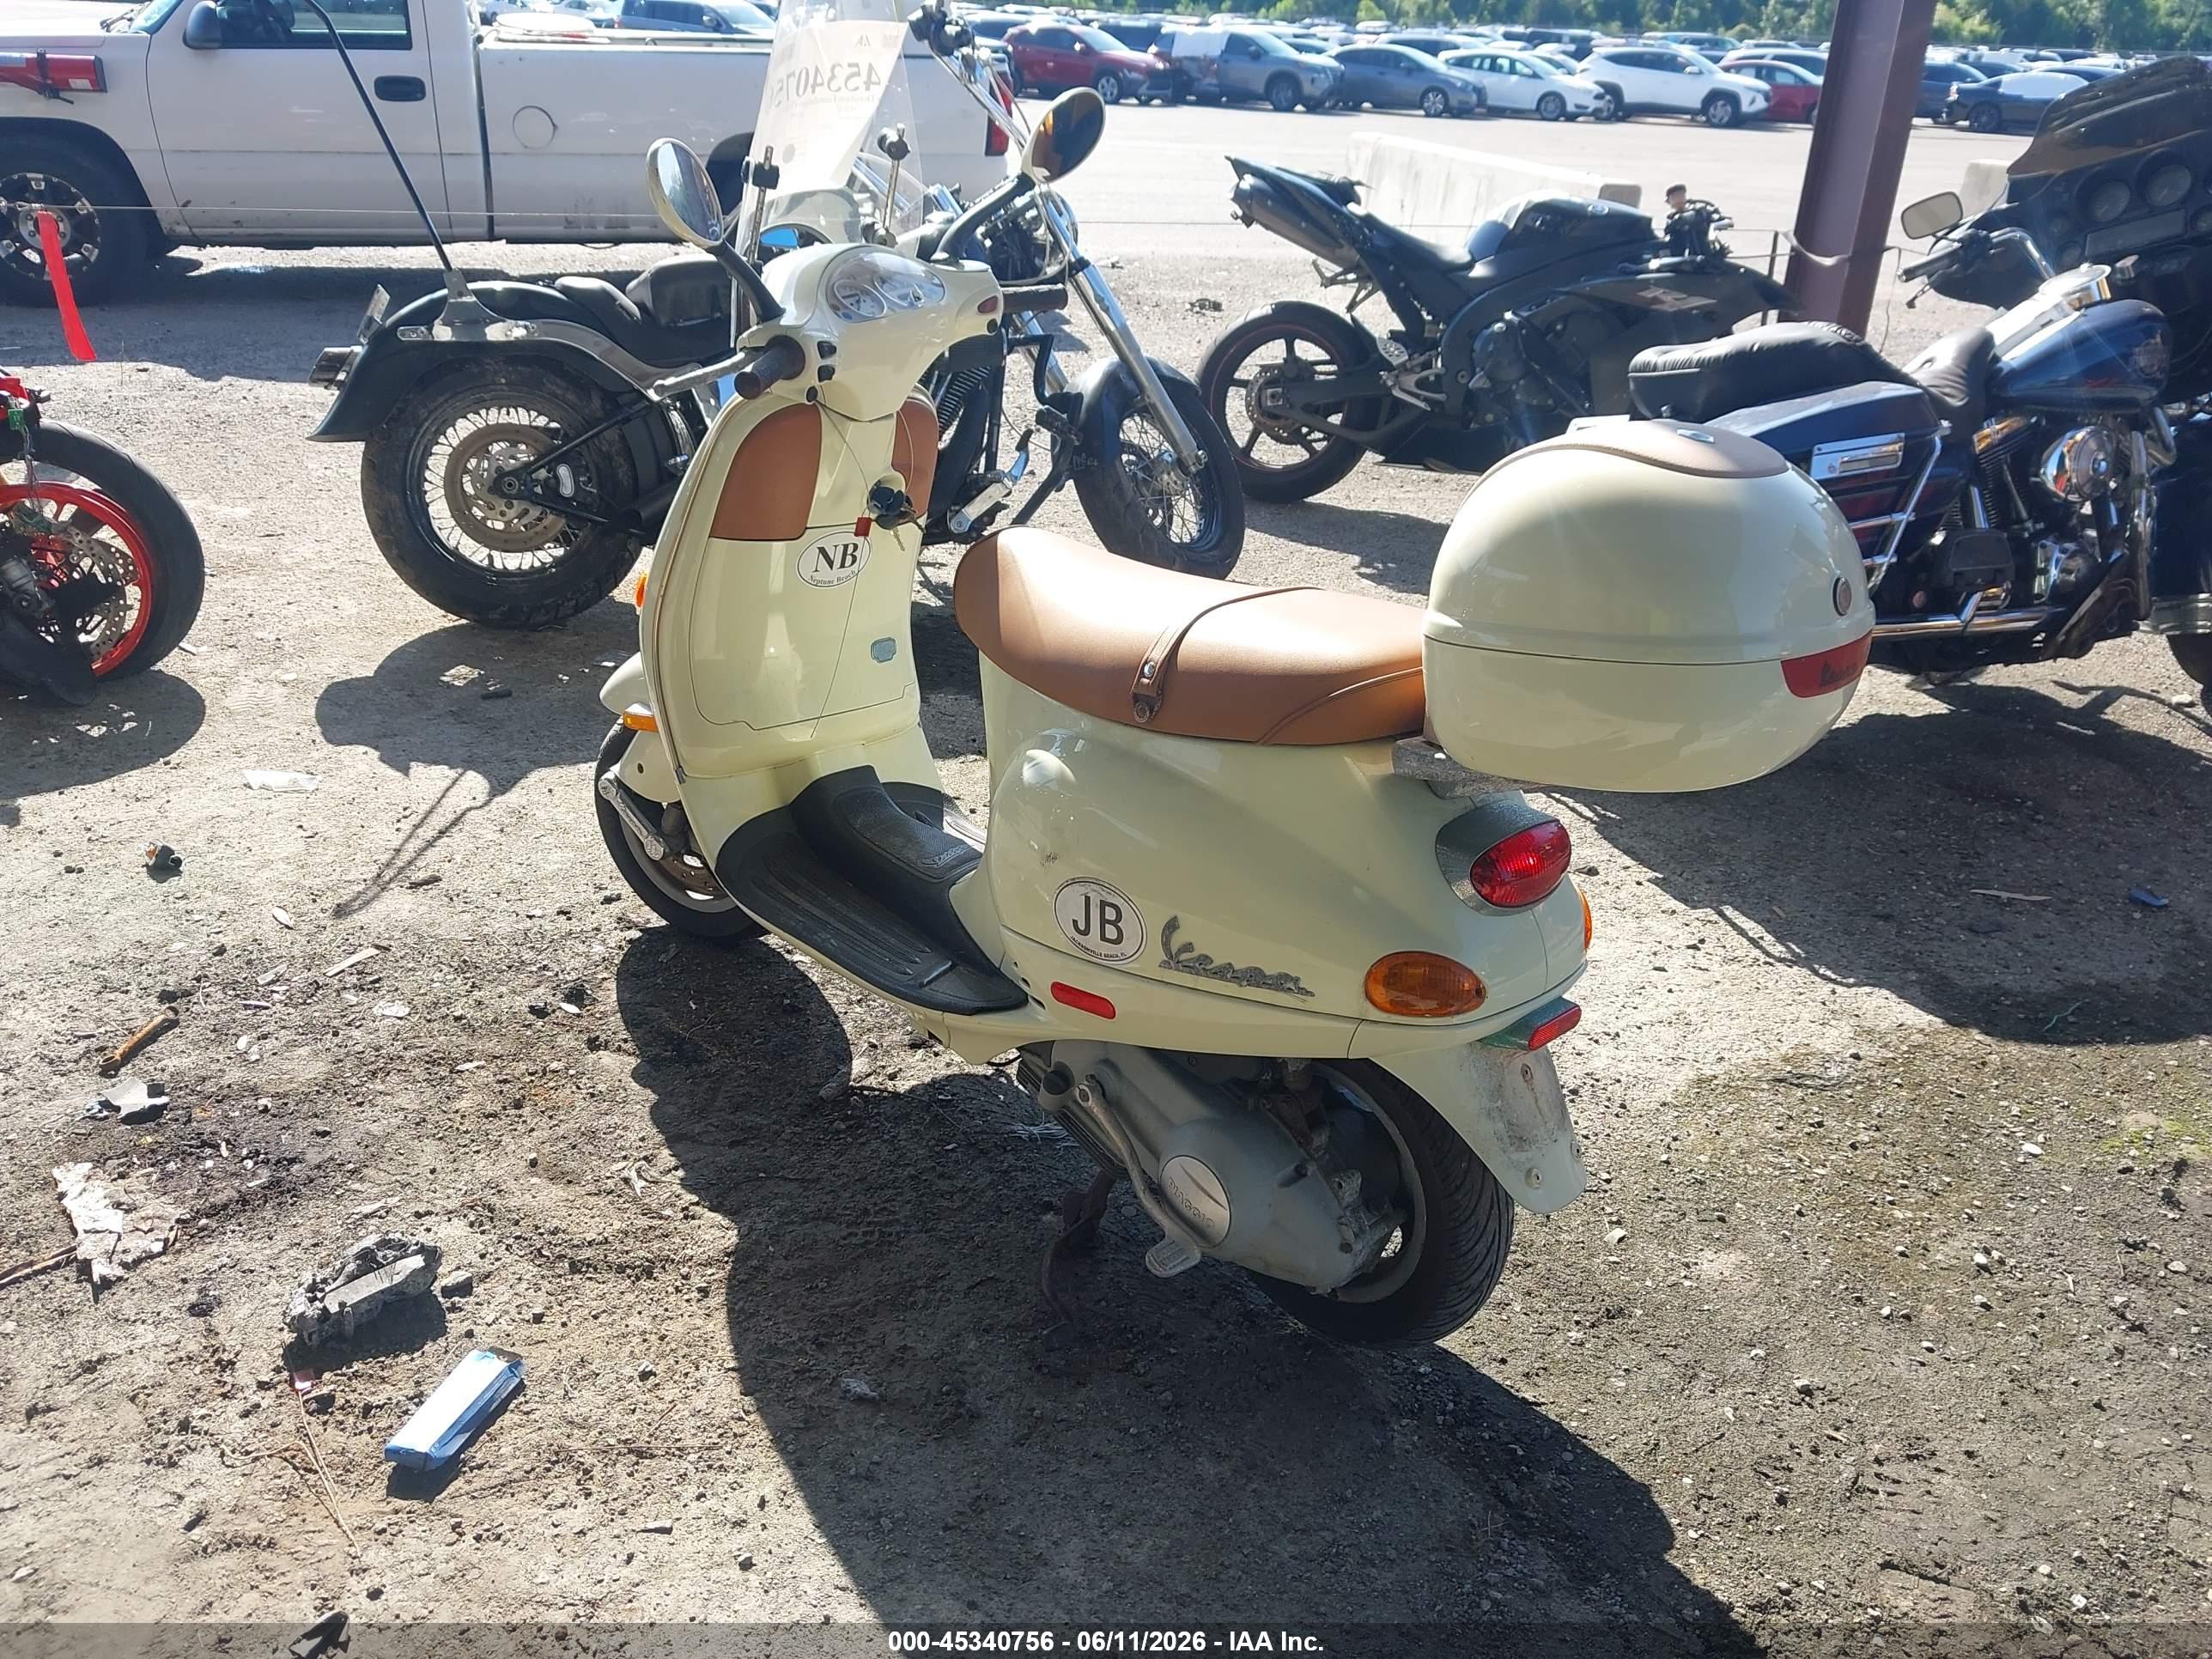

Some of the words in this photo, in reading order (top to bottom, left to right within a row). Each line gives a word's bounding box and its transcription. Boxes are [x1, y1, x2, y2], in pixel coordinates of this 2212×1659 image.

[808, 574, 835, 585] Neptune
[836, 569, 856, 583] Beach
[811, 542, 859, 573] NB
[1072, 894, 1124, 945] JB
[1169, 1175, 1215, 1230] PIAGGIO
